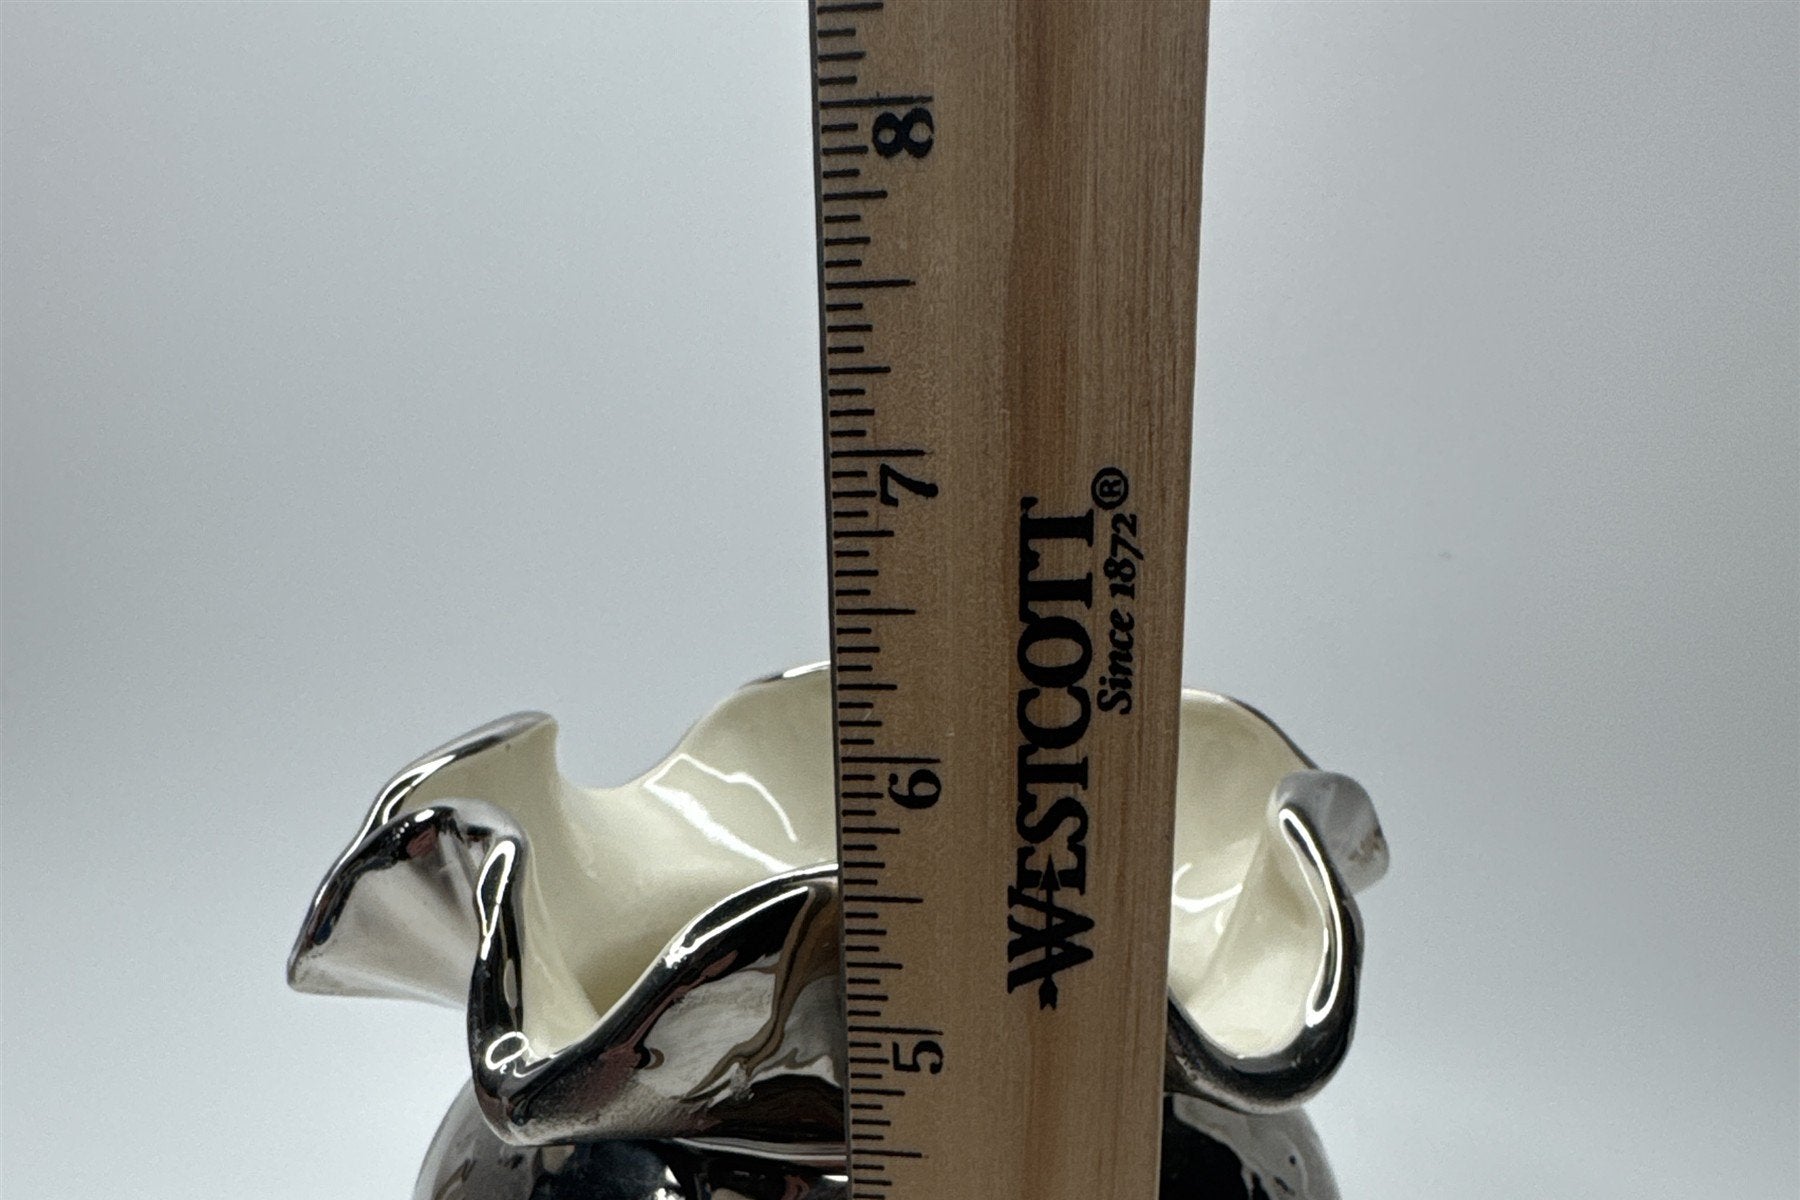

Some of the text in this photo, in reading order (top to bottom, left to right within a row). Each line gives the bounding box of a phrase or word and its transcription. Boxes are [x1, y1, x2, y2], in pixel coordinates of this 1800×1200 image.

[871, 107, 934, 159] 8
[879, 463, 939, 507] 7
[1096, 513, 1145, 715] Since 1872
[1006, 496, 1095, 995] WESTCOTT
[888, 769, 942, 810] 6
[893, 1039, 944, 1075] 5
